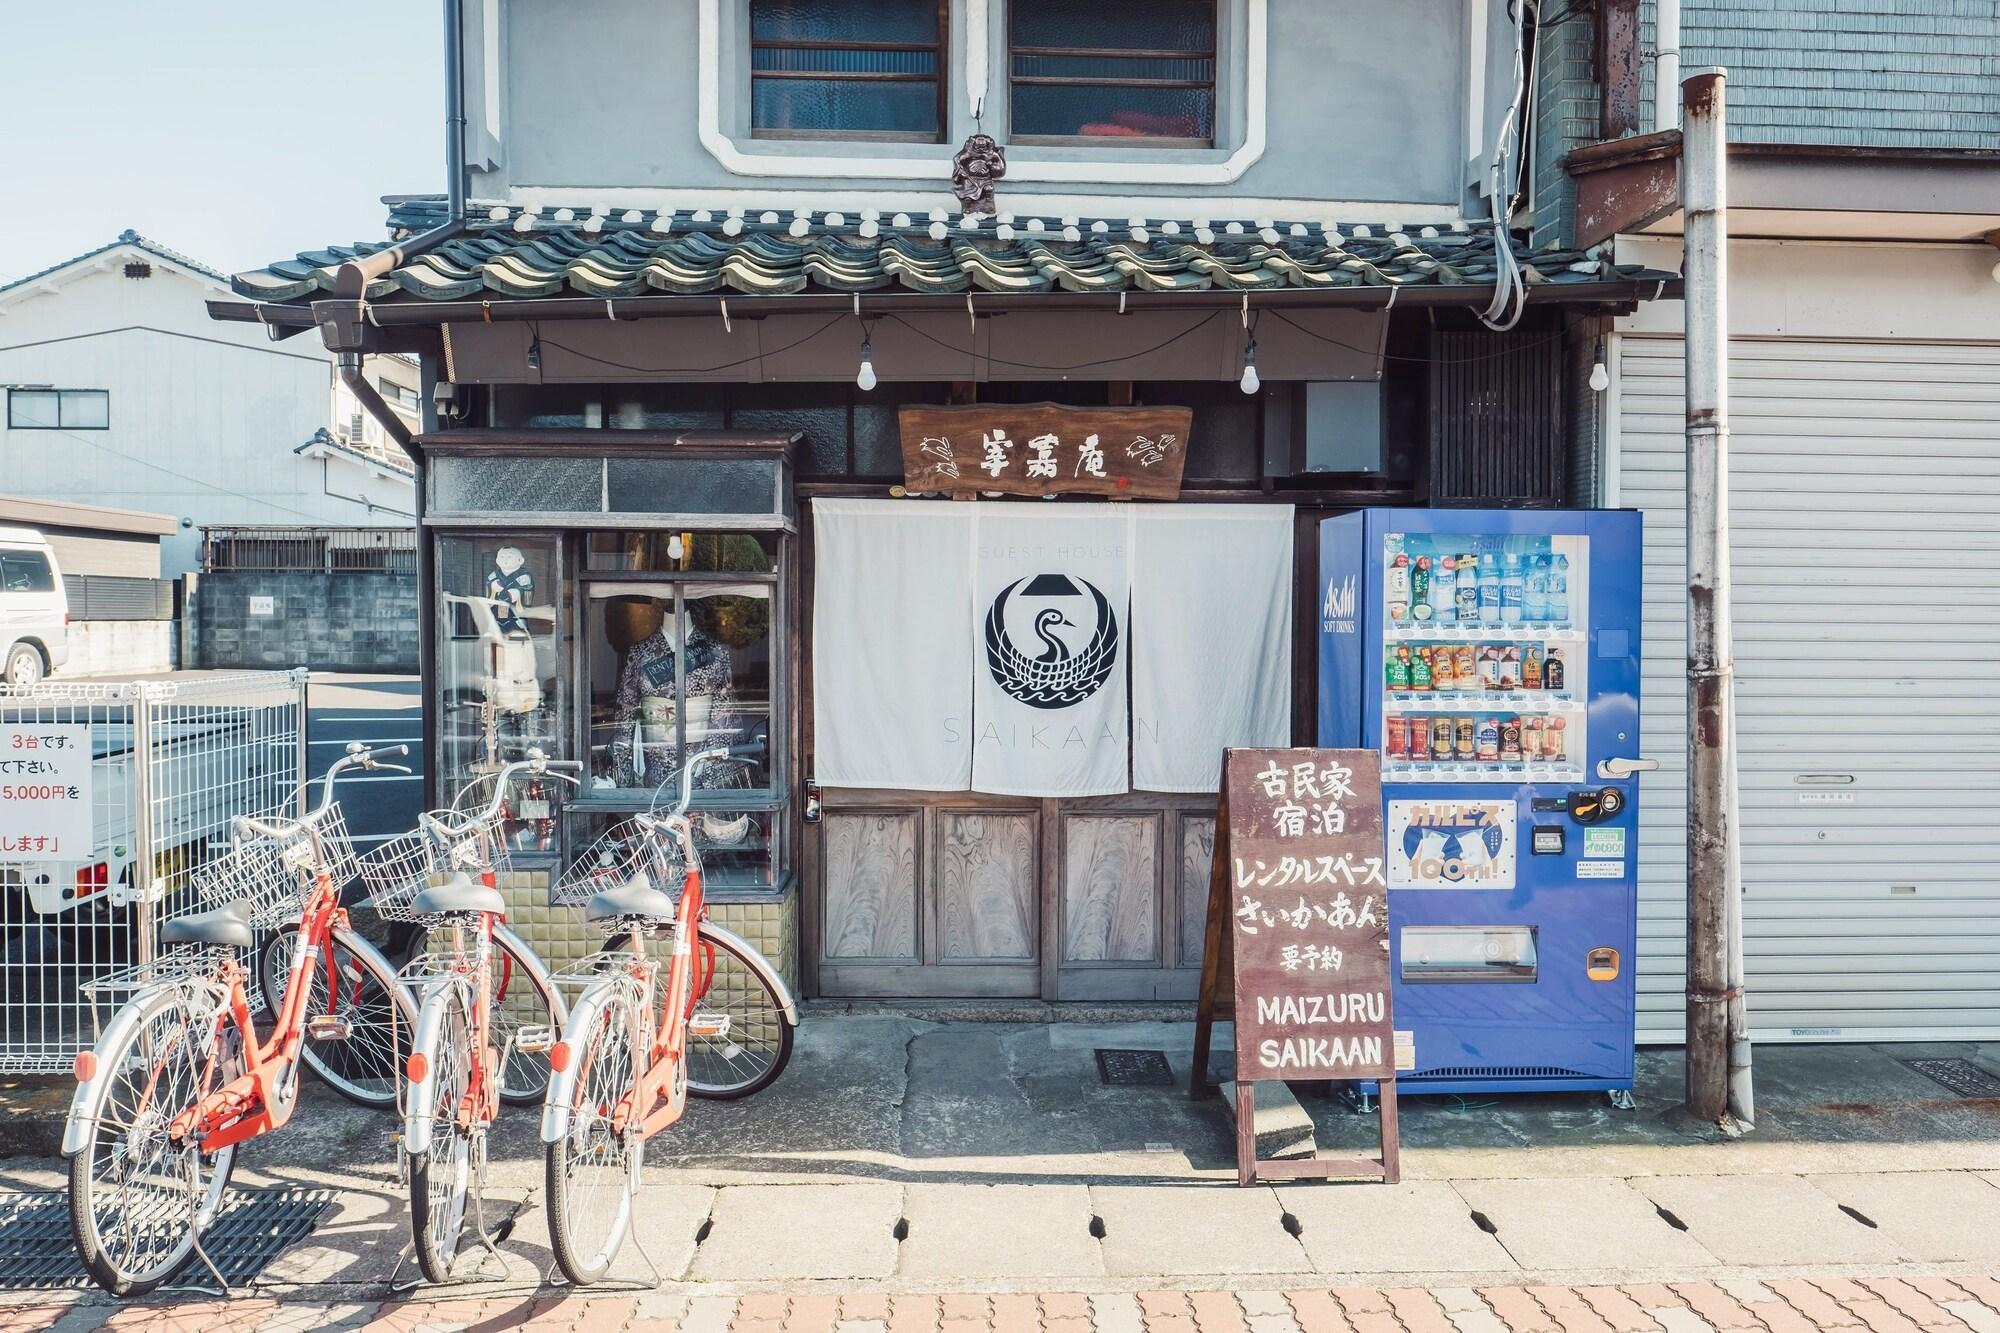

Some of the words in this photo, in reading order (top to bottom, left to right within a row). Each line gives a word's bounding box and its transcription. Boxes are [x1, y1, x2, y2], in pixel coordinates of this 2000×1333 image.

[978, 545, 1045, 560] GUEST
[1057, 544, 1125, 560] HOUSE
[1324, 574, 1355, 618] Asahi
[1324, 620, 1335, 632] SOFT
[1336, 620, 1354, 633] DRINKS
[12, 734, 74, 750] 3台です。
[943, 717, 1159, 749] SAIKAAN
[0, 760, 58, 775] て下さい。
[1257, 760, 1357, 800] 古民家
[3, 785, 80, 800] 5,000円を
[1273, 800, 1345, 837] 宿泊
[1410, 805, 1499, 827] カルピス
[0, 835, 58, 852] します」
[1235, 852, 1387, 888] レンタルスペース
[1236, 891, 1379, 935] さいかあん
[1280, 944, 1343, 971] 要予約
[1257, 992, 1385, 1025] MAIZURU
[1259, 1036, 1382, 1068] SAIKAAN
